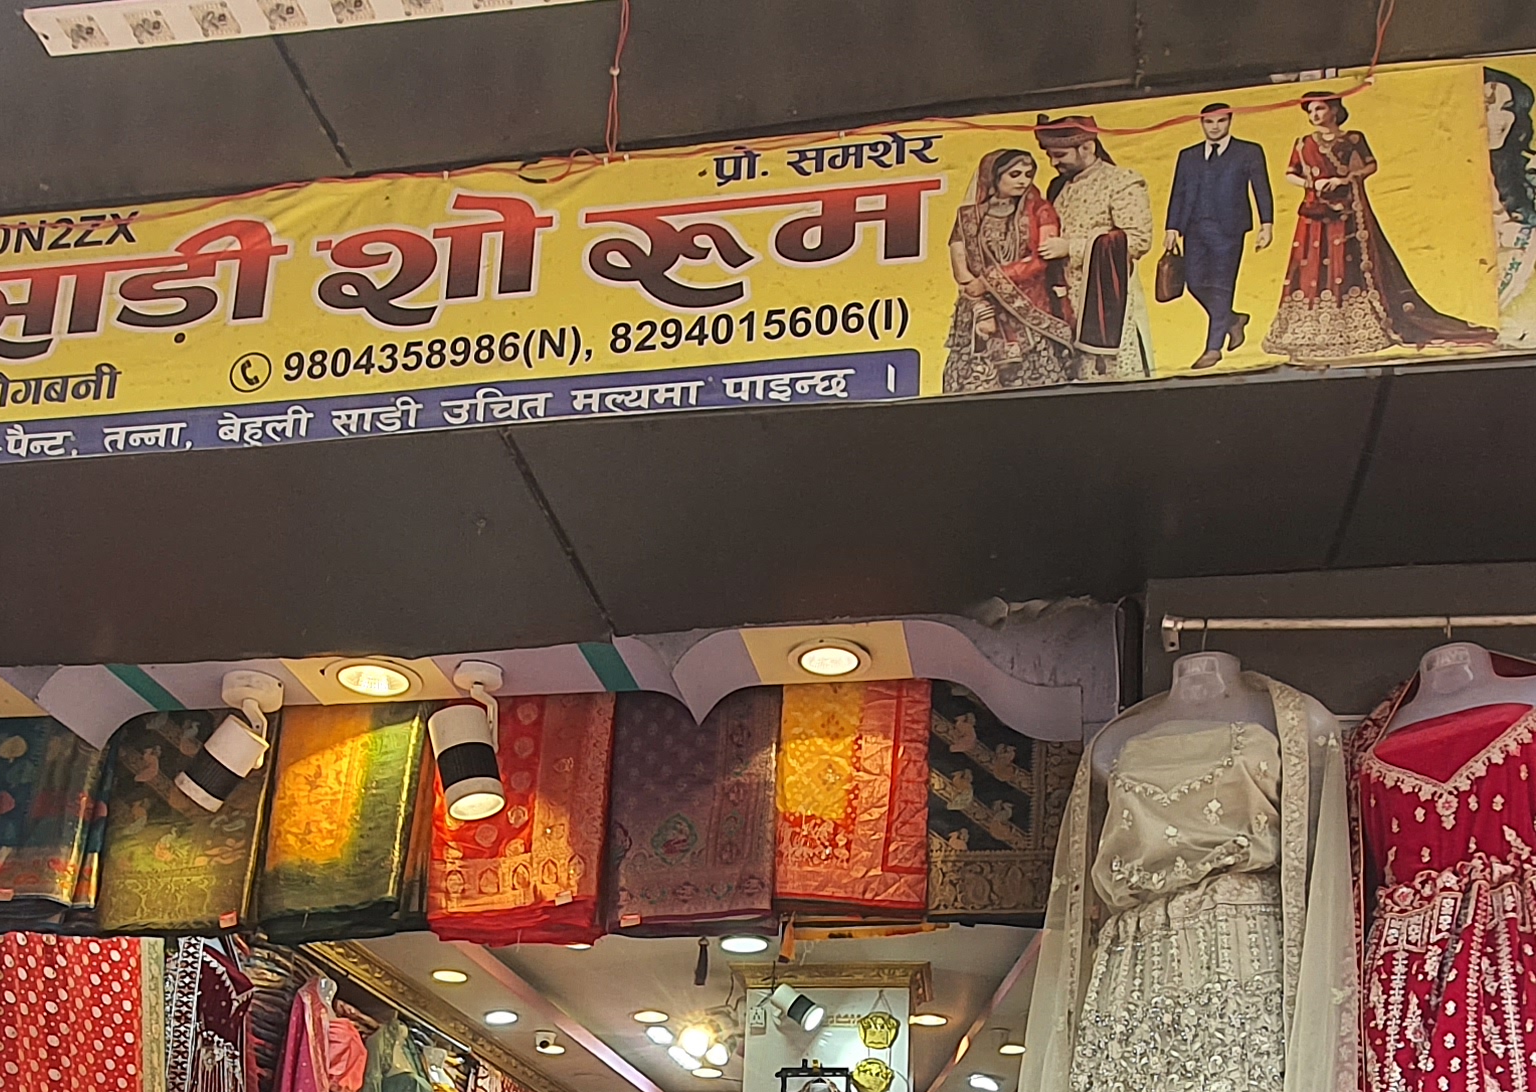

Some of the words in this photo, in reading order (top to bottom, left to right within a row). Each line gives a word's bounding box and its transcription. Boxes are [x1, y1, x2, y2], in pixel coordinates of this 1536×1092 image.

[713, 147, 770, 187] प्रो.
[785, 133, 944, 178] समशेर
[317, 192, 556, 328] शो
[583, 179, 942, 309] रूम
[281, 325, 595, 383] 9804358986(N),
[609, 296, 911, 356] 8294015606(I)
[102, 421, 193, 452] तन्ना,
[440, 387, 553, 425] उचित
[722, 369, 855, 400] पाइन्छ
